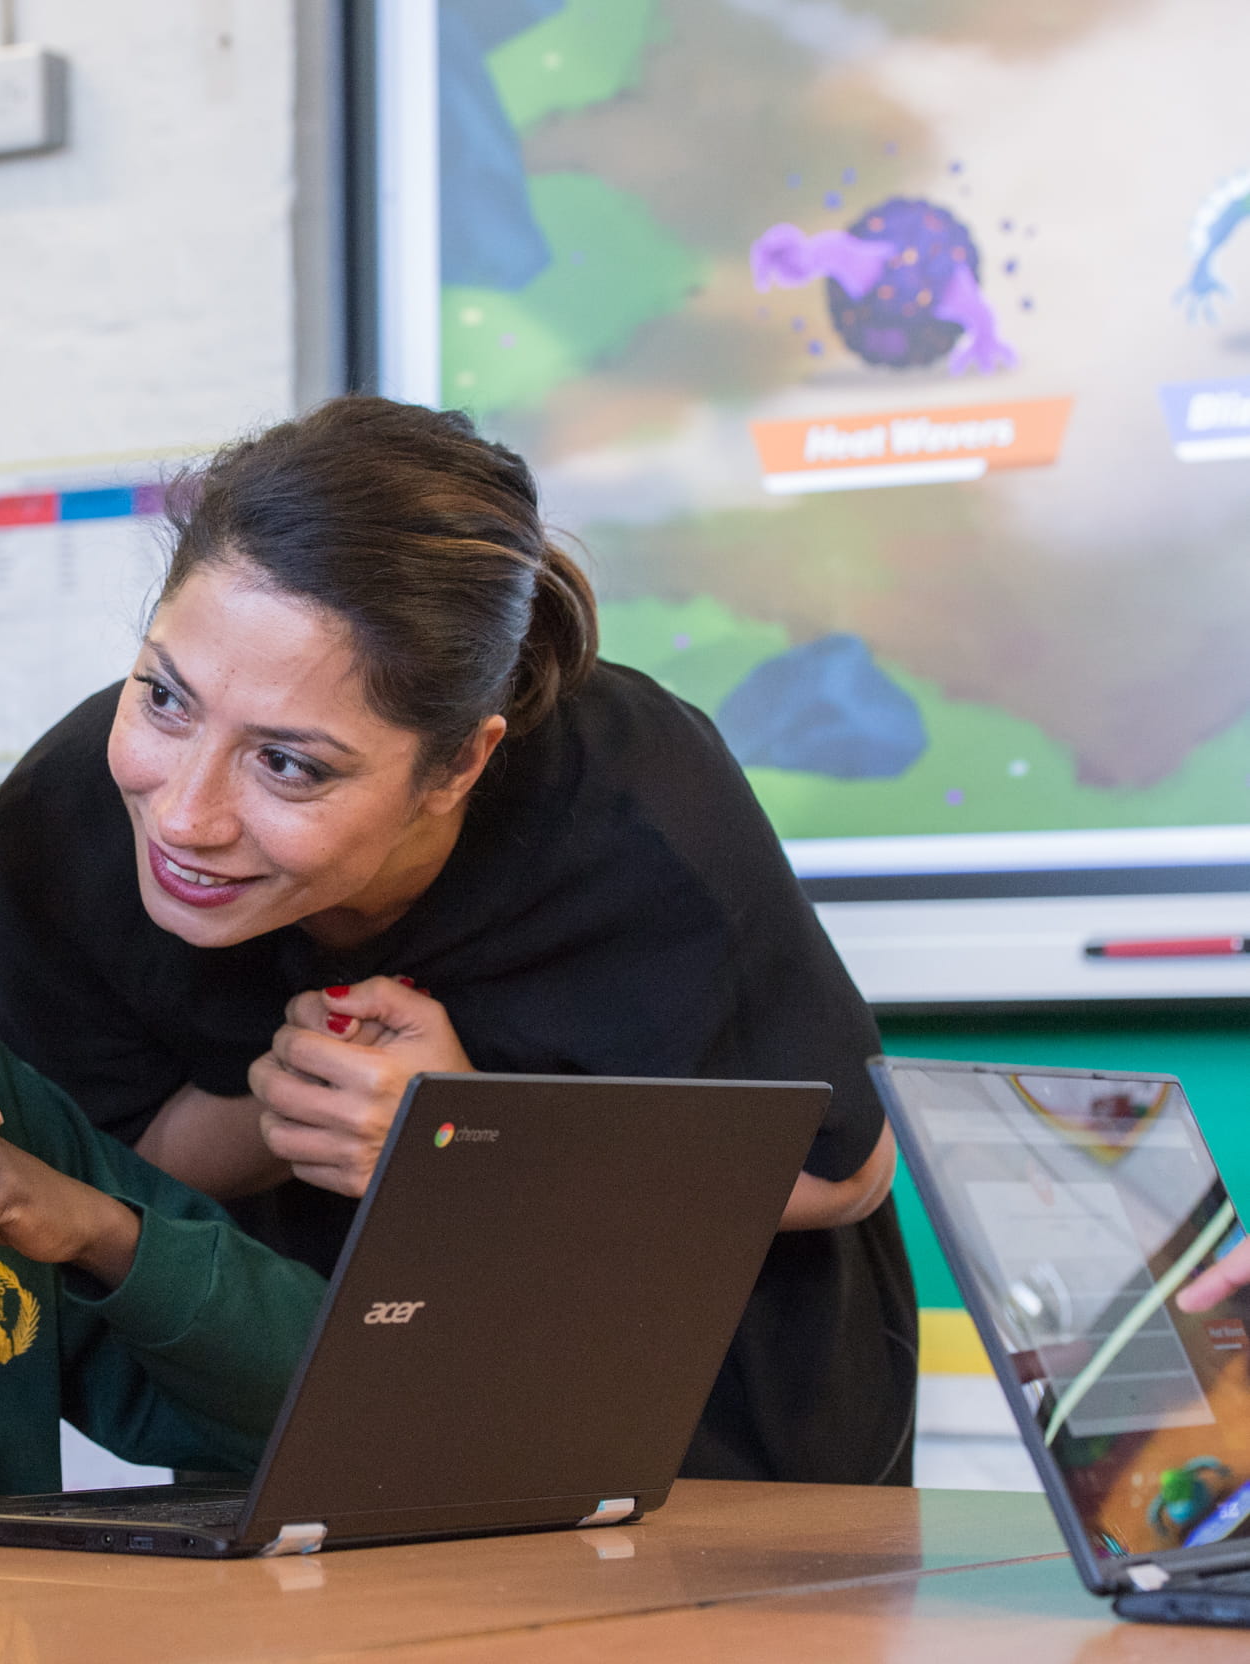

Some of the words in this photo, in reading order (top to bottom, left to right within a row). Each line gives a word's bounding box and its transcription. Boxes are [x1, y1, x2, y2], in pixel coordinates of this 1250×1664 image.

[804, 424, 886, 461] Heat
[890, 417, 1015, 455] Wavers
[454, 1126, 499, 1142] chrome
[364, 1302, 426, 1324] acer
